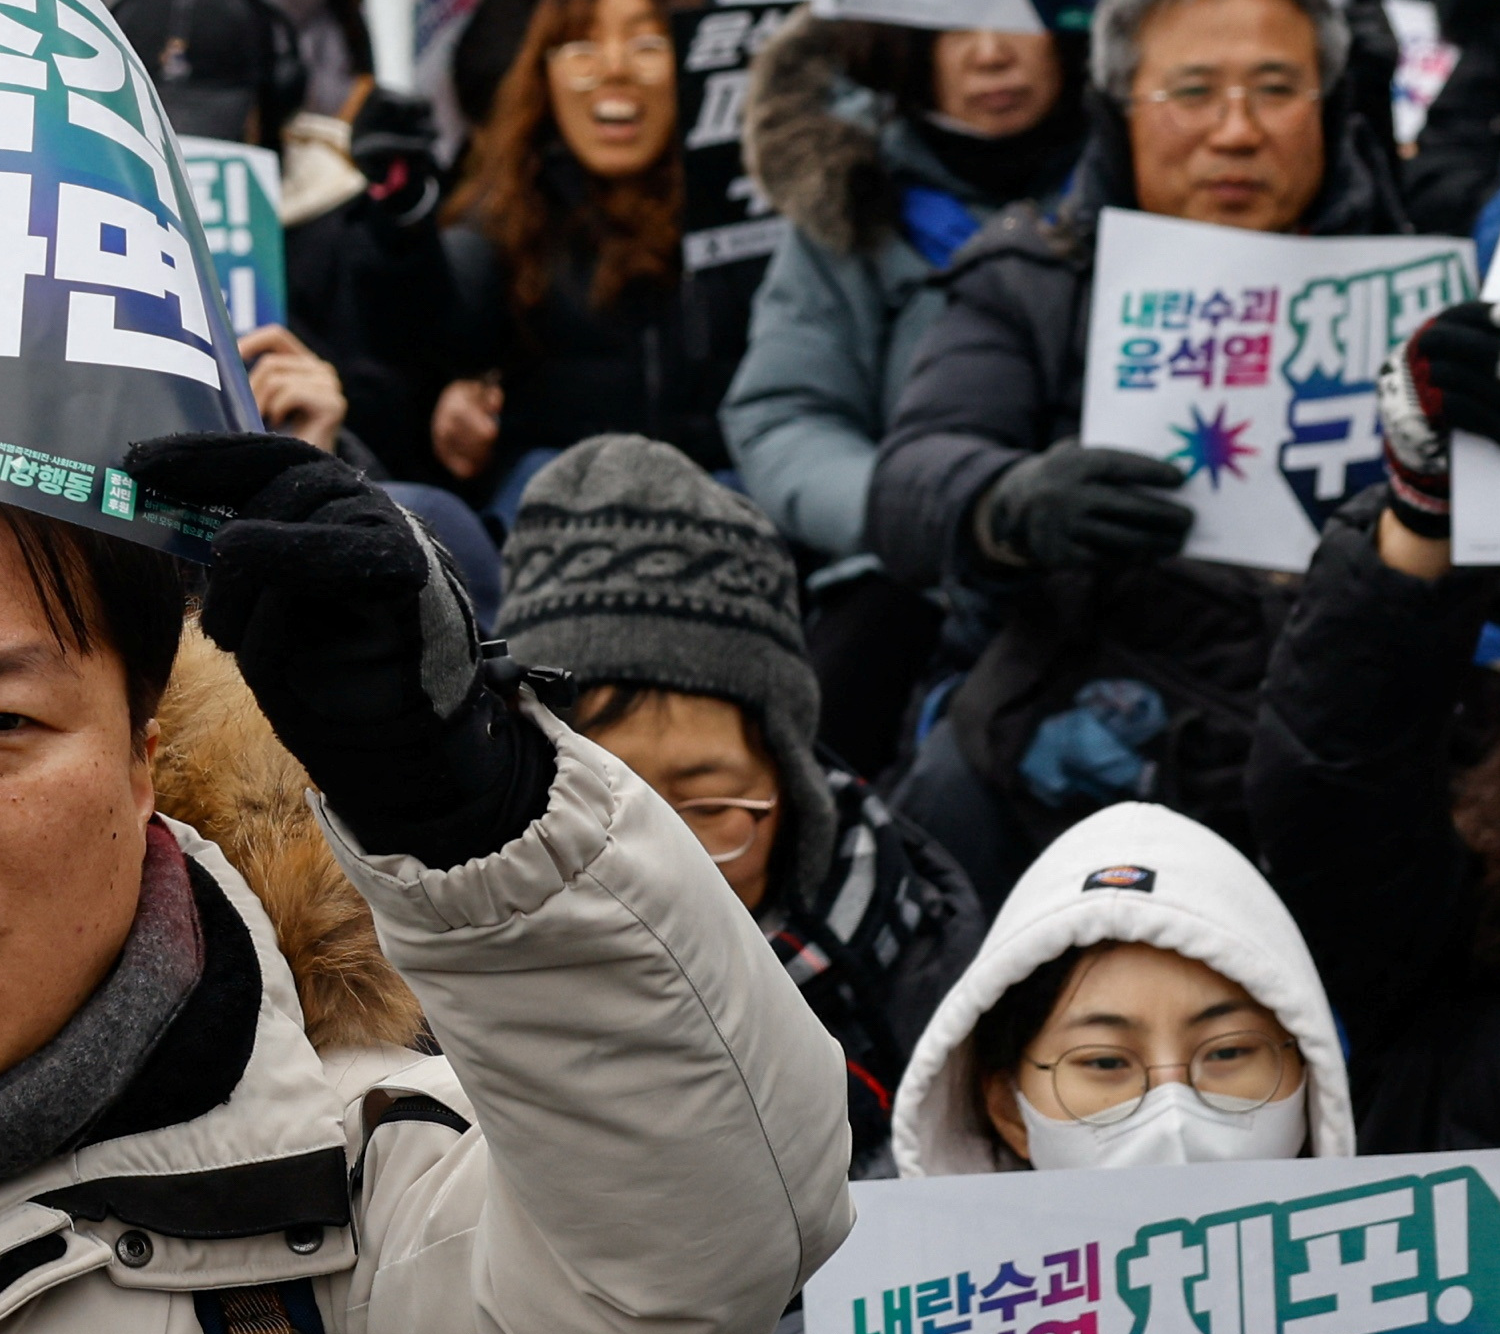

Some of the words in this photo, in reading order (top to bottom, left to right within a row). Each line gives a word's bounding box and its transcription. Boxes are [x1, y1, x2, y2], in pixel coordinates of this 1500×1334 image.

[1120, 285, 1281, 330] 내란수괴
[1116, 333, 1271, 391] 윤석열
[109, 472, 133, 489] 공식
[109, 486, 132, 501] 시민
[107, 498, 130, 514] 후원
